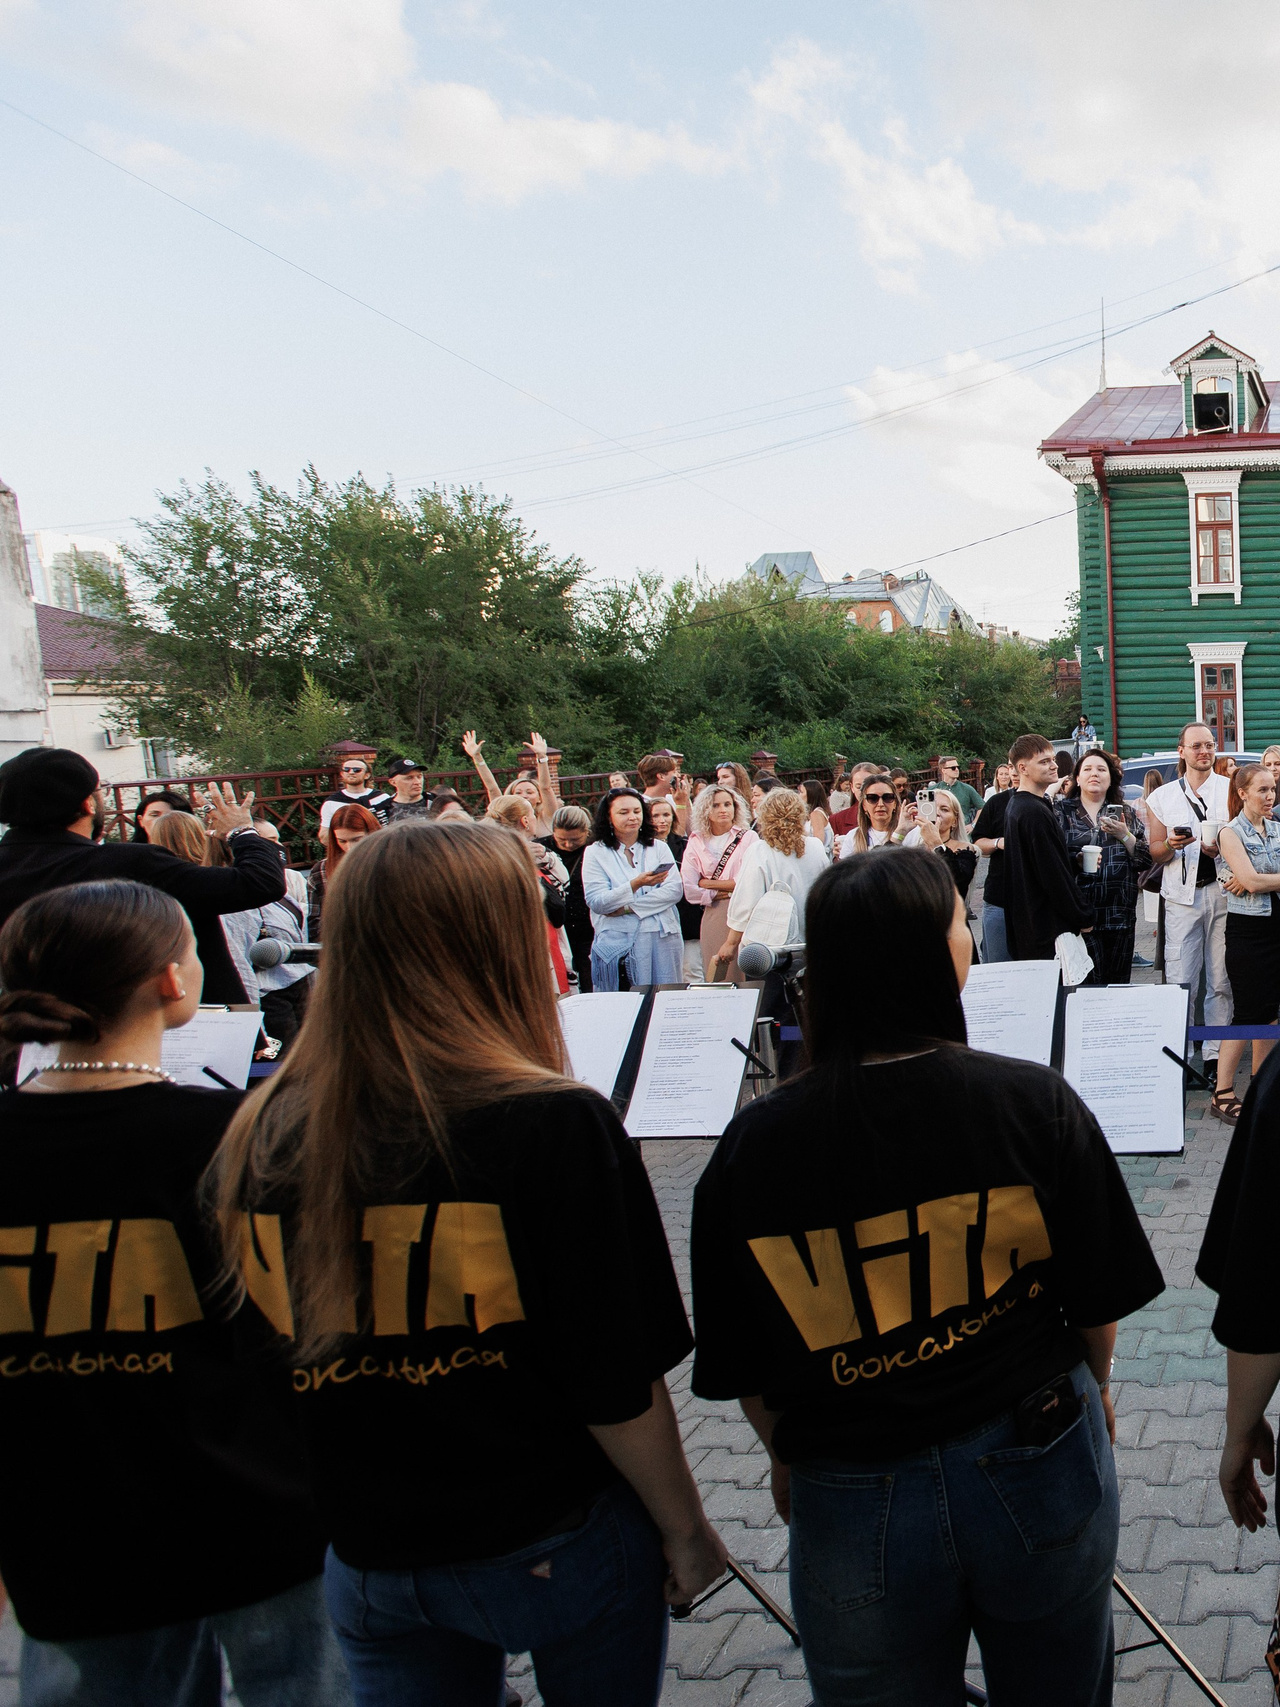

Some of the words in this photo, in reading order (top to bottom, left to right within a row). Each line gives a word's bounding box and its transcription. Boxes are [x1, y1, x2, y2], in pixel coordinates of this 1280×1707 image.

[222, 1202, 527, 1342] VTA
[747, 1185, 1053, 1352] ViTA
[293, 1347, 509, 1393] окальная
